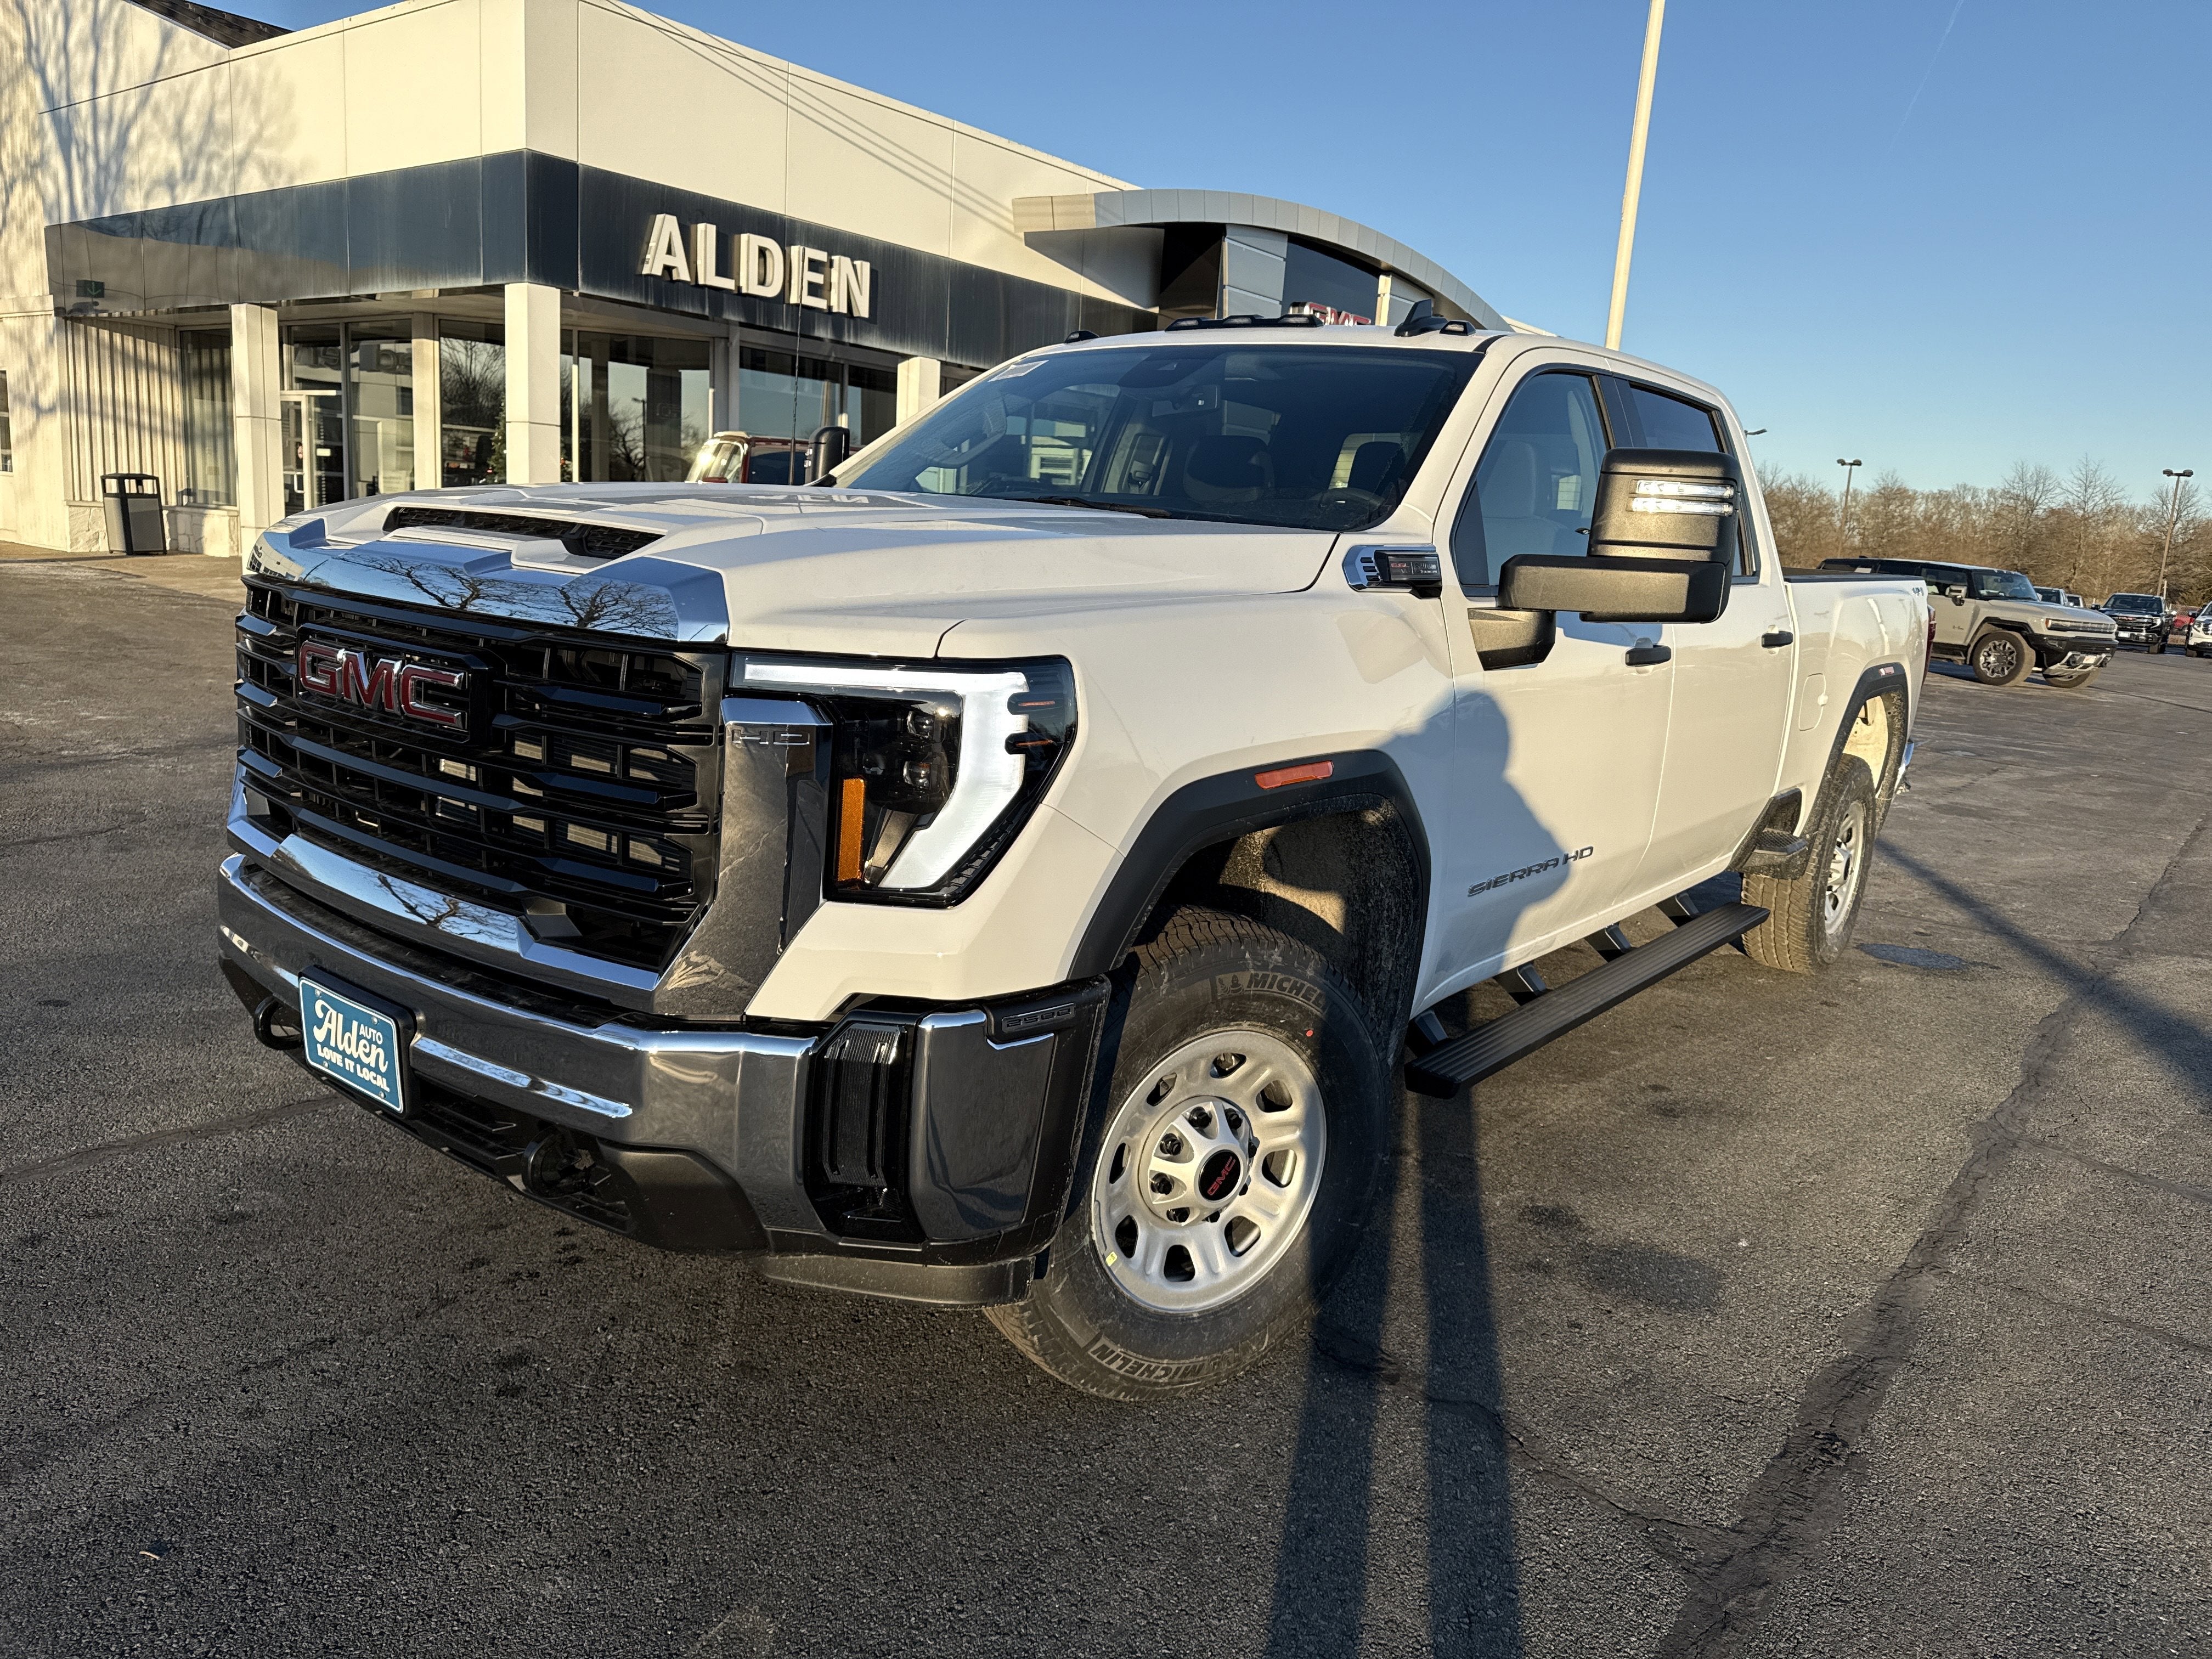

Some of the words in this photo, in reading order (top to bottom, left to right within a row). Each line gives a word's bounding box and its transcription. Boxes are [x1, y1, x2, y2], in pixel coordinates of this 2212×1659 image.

[641, 213, 870, 318] ALDEN
[300, 640, 464, 729] GMC
[731, 729, 810, 746] HD
[1467, 857, 1560, 898] SIERRA
[1561, 845, 1594, 866] HD
[1246, 972, 1325, 1009] MICHEL
[313, 999, 388, 1073] Alden
[359, 1024, 383, 1045] AUTO
[317, 1043, 343, 1068] LOVE
[345, 1057, 355, 1073] IT
[356, 1063, 390, 1092] LOCAL
[1207, 1156, 1236, 1196] GMC
[1090, 1344, 1207, 1380] MICHELIN
